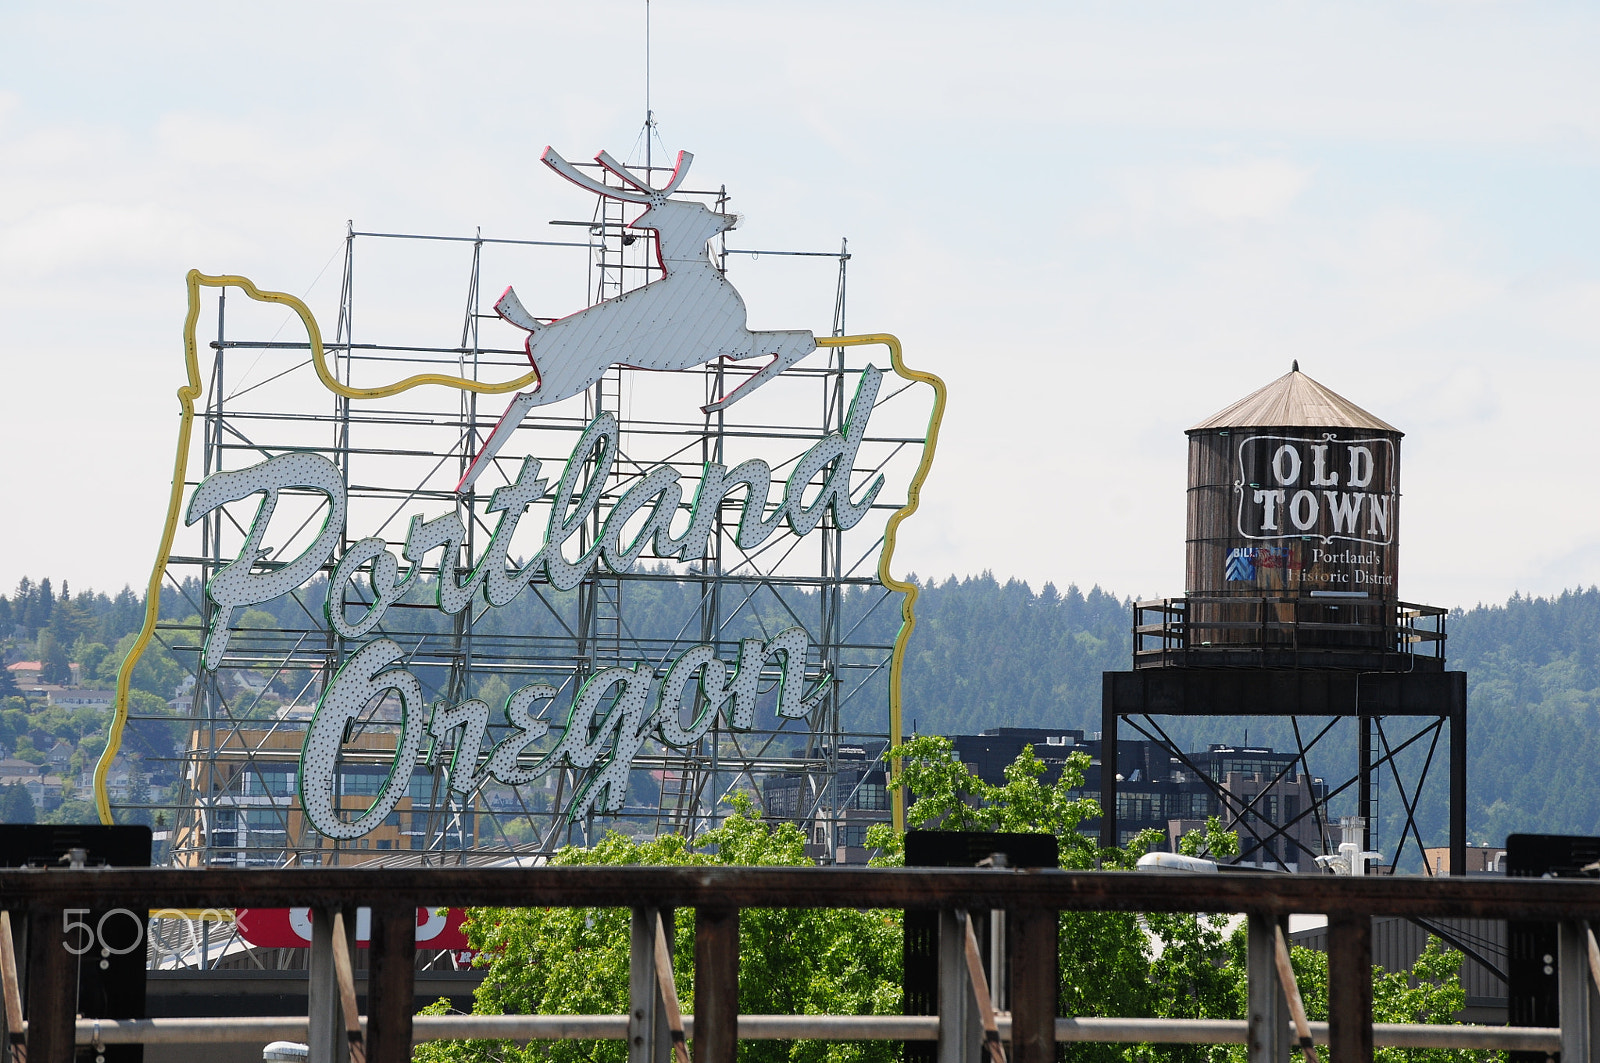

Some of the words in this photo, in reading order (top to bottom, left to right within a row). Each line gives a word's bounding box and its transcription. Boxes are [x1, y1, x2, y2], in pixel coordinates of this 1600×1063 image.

[1271, 444, 1375, 488] OLD
[185, 363, 885, 671] Portland
[1253, 489, 1390, 537] TOWN
[1312, 548, 1381, 565] Portland's
[1354, 569, 1393, 586] District
[299, 627, 832, 840] Oregon
